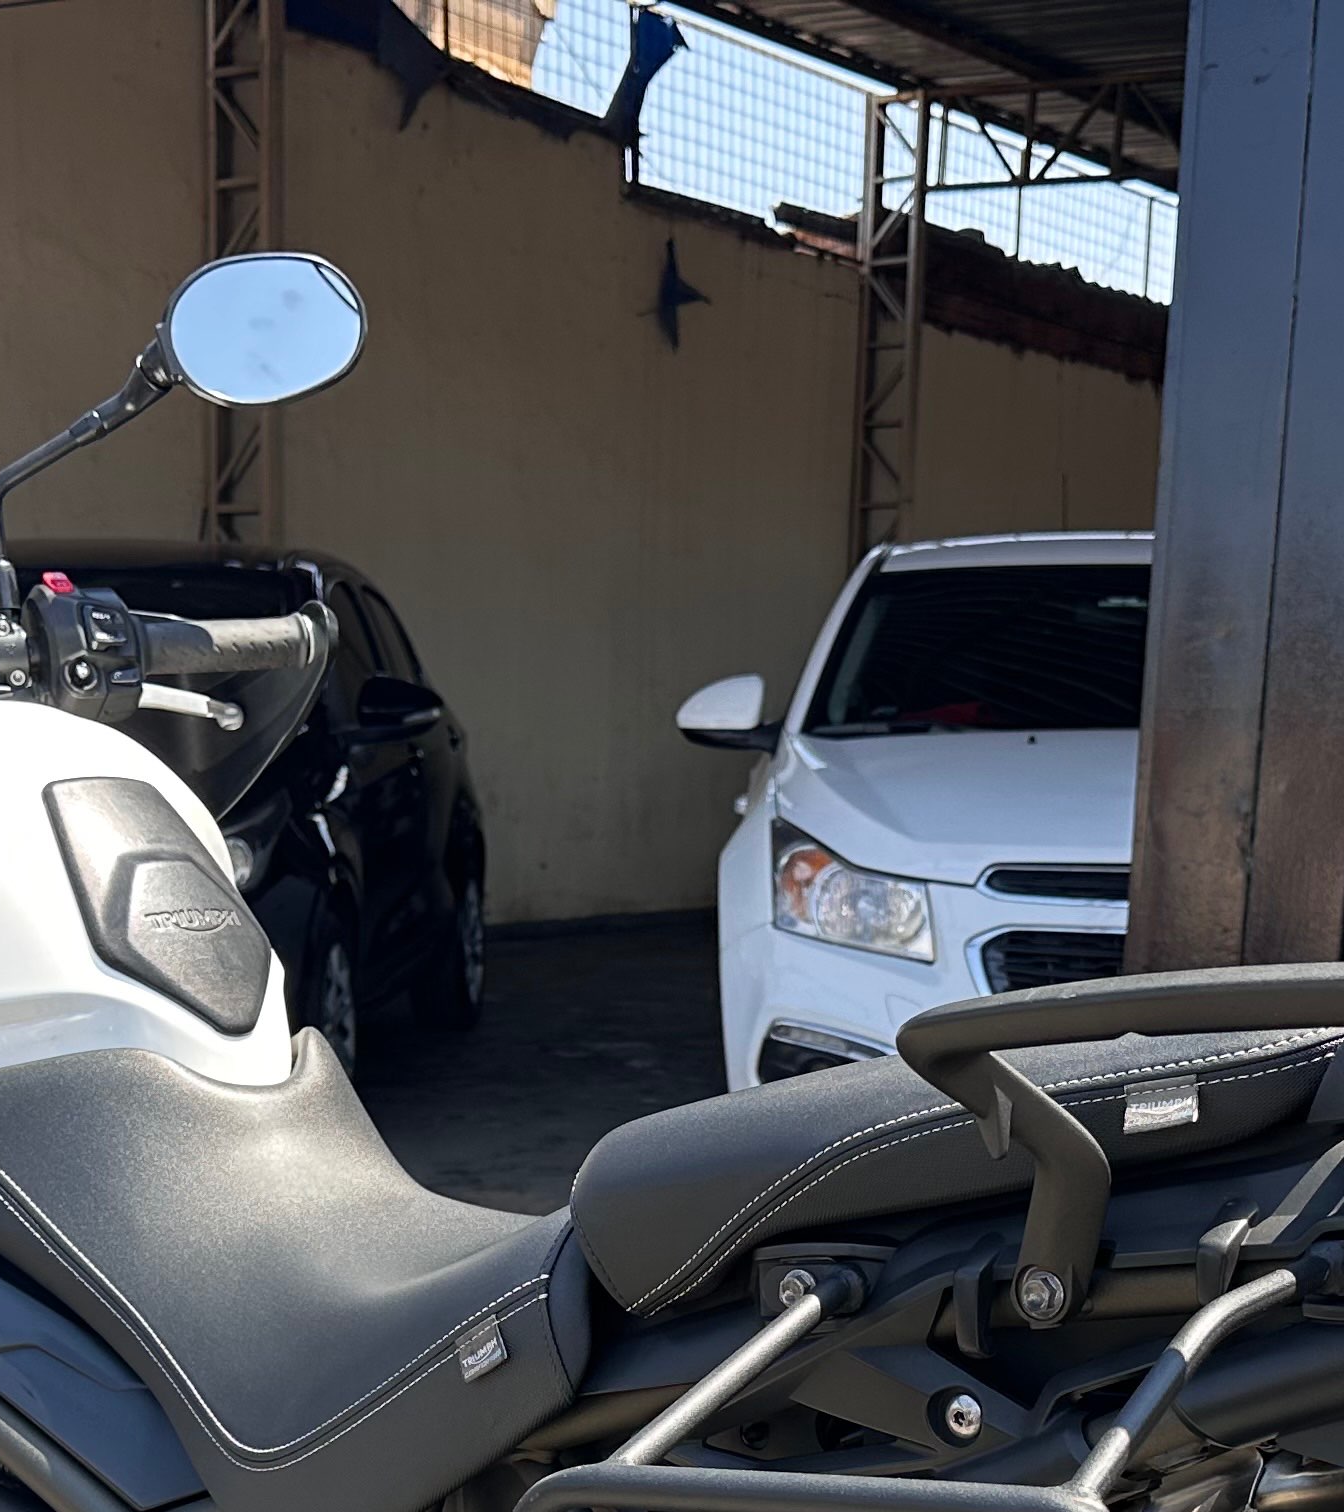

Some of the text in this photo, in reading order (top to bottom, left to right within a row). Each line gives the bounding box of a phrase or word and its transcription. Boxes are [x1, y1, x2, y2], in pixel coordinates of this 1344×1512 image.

[144, 907, 241, 932] TRIUMPH
[1130, 1094, 1194, 1115] TRIUMPH
[462, 1336, 498, 1368] TRIUMPH
